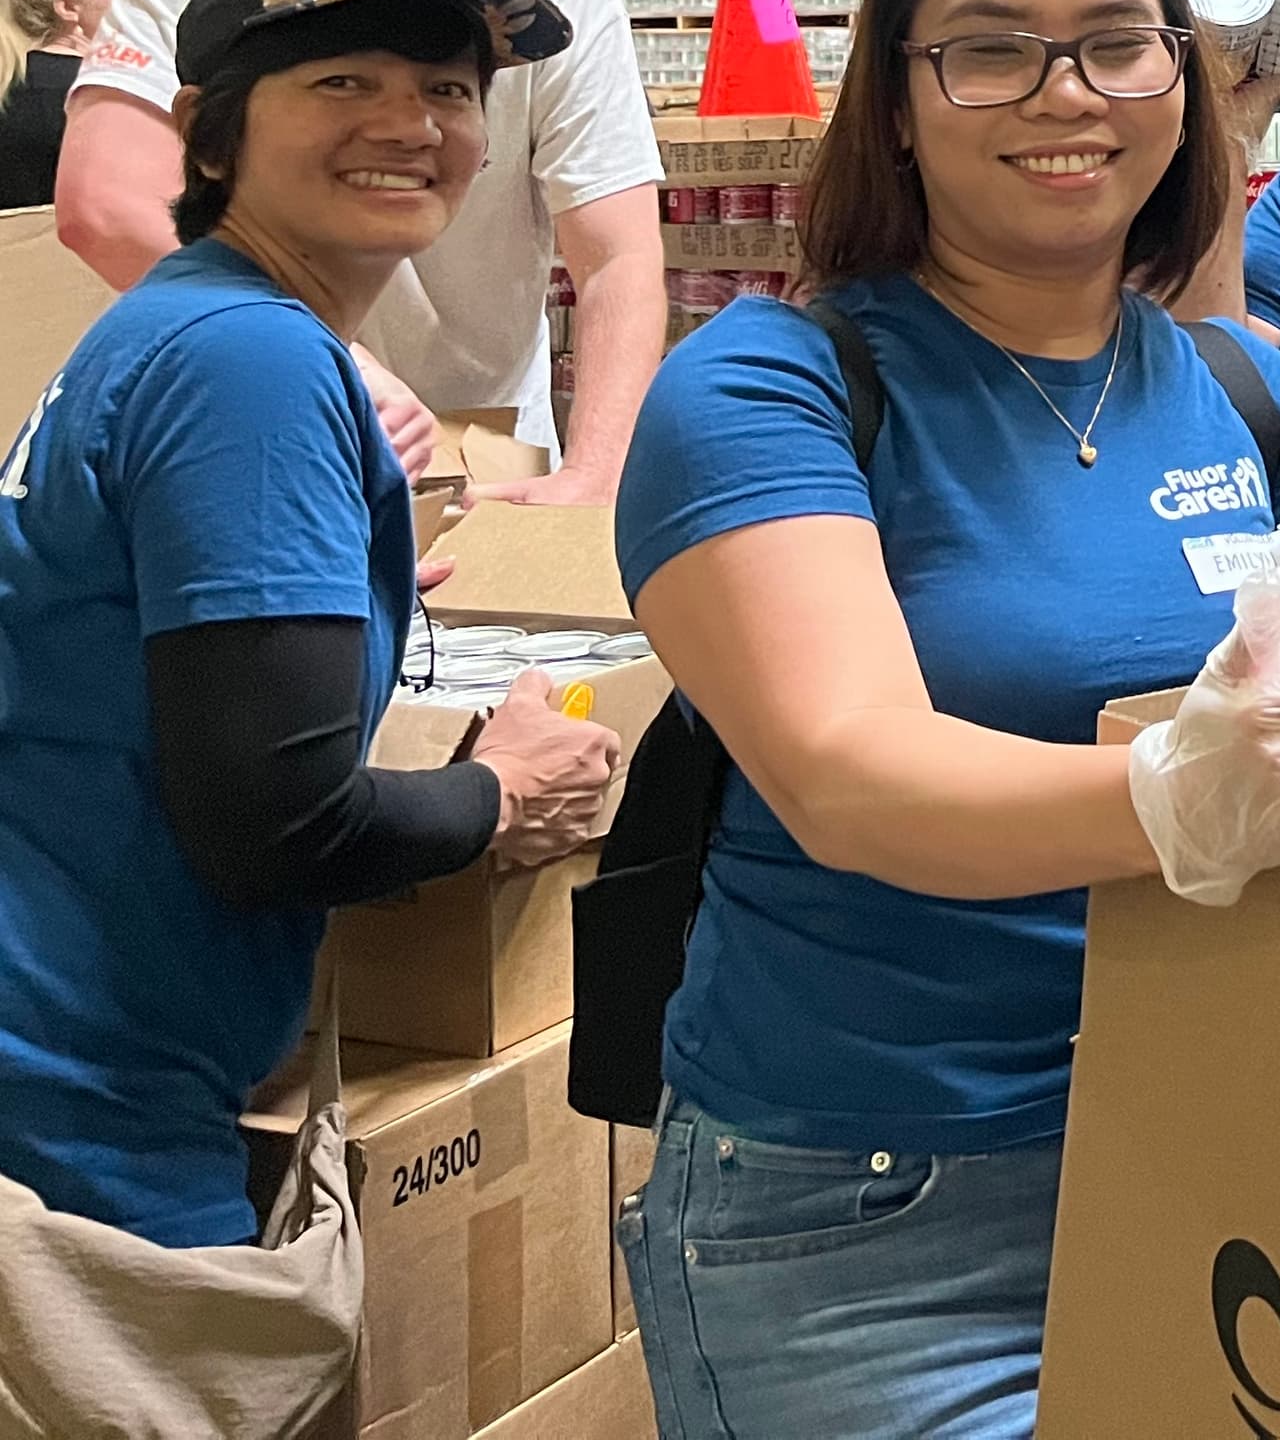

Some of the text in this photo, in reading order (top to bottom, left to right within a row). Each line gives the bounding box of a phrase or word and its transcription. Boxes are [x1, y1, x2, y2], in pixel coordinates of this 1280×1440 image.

[1163, 463, 1228, 492] Fluor
[1149, 483, 1242, 521] Cares
[392, 1128, 481, 1208] 24/300
